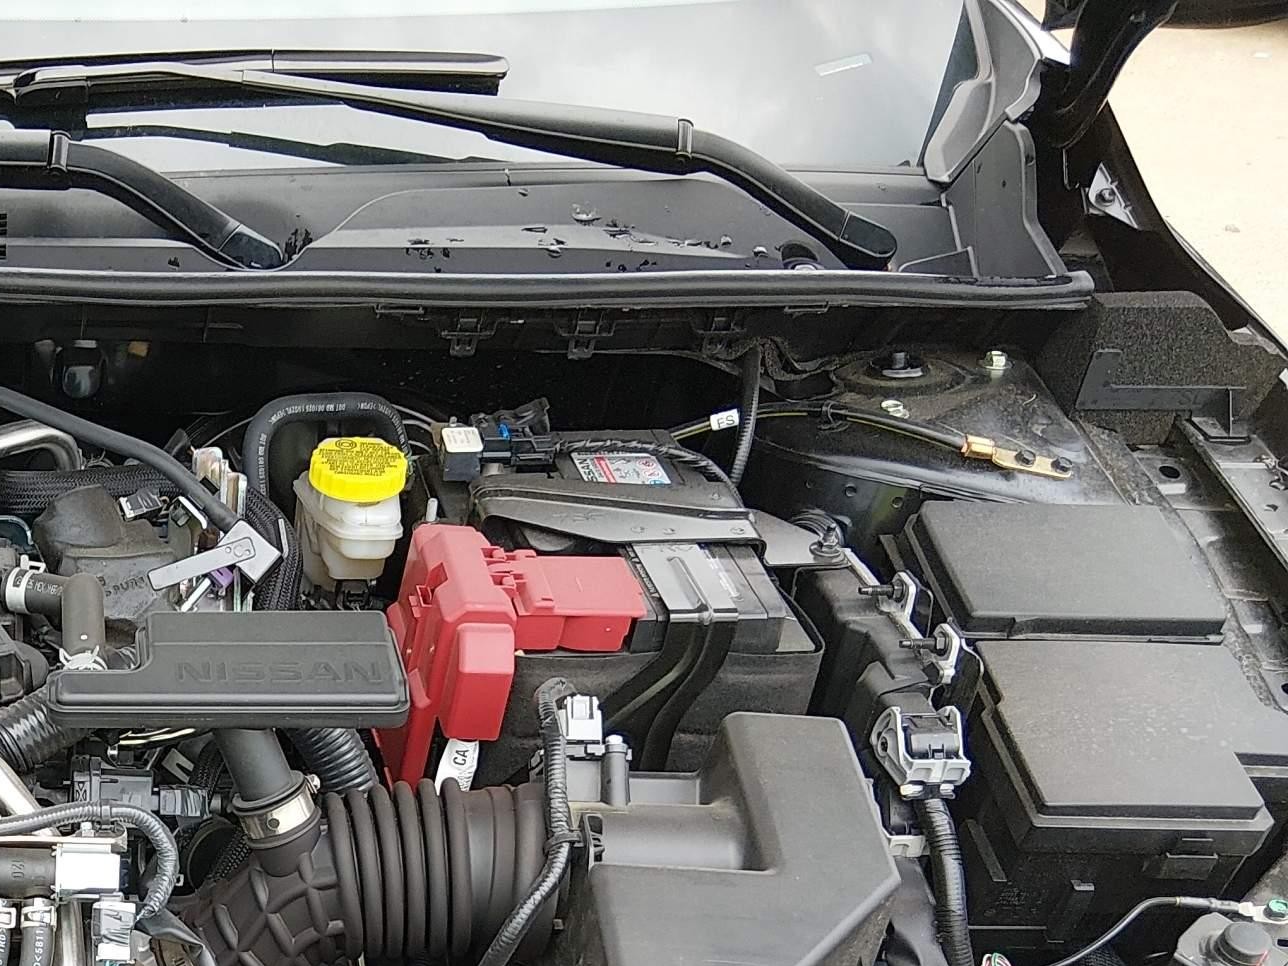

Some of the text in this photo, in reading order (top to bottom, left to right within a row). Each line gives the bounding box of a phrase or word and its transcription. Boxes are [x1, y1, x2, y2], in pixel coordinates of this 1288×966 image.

[716, 414, 736, 429] FS
[174, 658, 384, 686] NISSAN
[453, 749, 470, 766] CA
